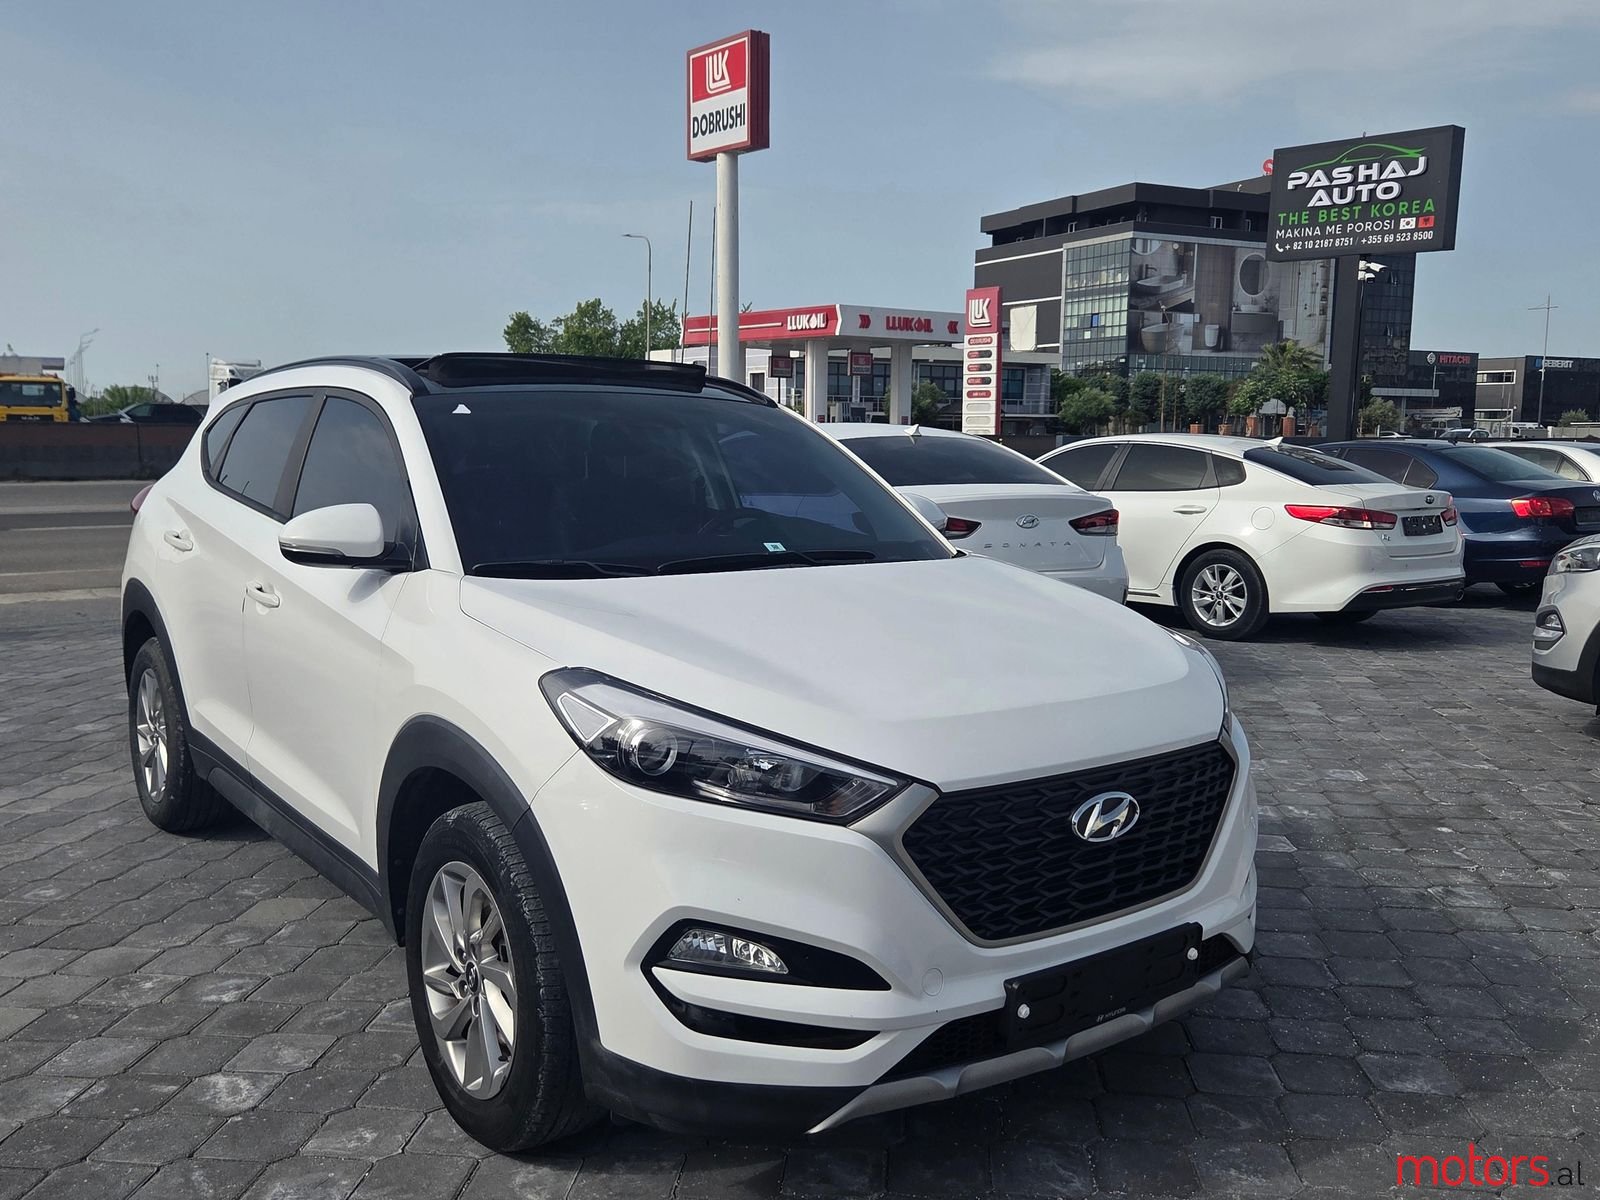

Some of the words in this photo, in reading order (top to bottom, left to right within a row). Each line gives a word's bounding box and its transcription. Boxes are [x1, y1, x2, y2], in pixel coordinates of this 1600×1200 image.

[692, 103, 746, 138] DOBRUSHI
[1287, 156, 1428, 190] PASHAJ
[1307, 181, 1402, 208] AUTO
[1278, 211, 1310, 226] THE
[1318, 206, 1362, 223] BEST
[1371, 198, 1436, 218] KOREA
[1275, 225, 1321, 239] MAKINA
[1325, 223, 1343, 235] ME
[1347, 220, 1395, 233] POROSI
[1293, 241, 1302, 250] 82
[1304, 240, 1314, 249] 10
[1314, 239, 1334, 249] 2187
[1334, 238, 1354, 247] 8751
[1361, 235, 1382, 245] +355
[1384, 233, 1394, 243] 69
[1395, 232, 1411, 242] 523
[1413, 231, 1434, 241] 8500
[1439, 355, 1471, 364] HITACHI
[983, 541, 1072, 549] SONATA
